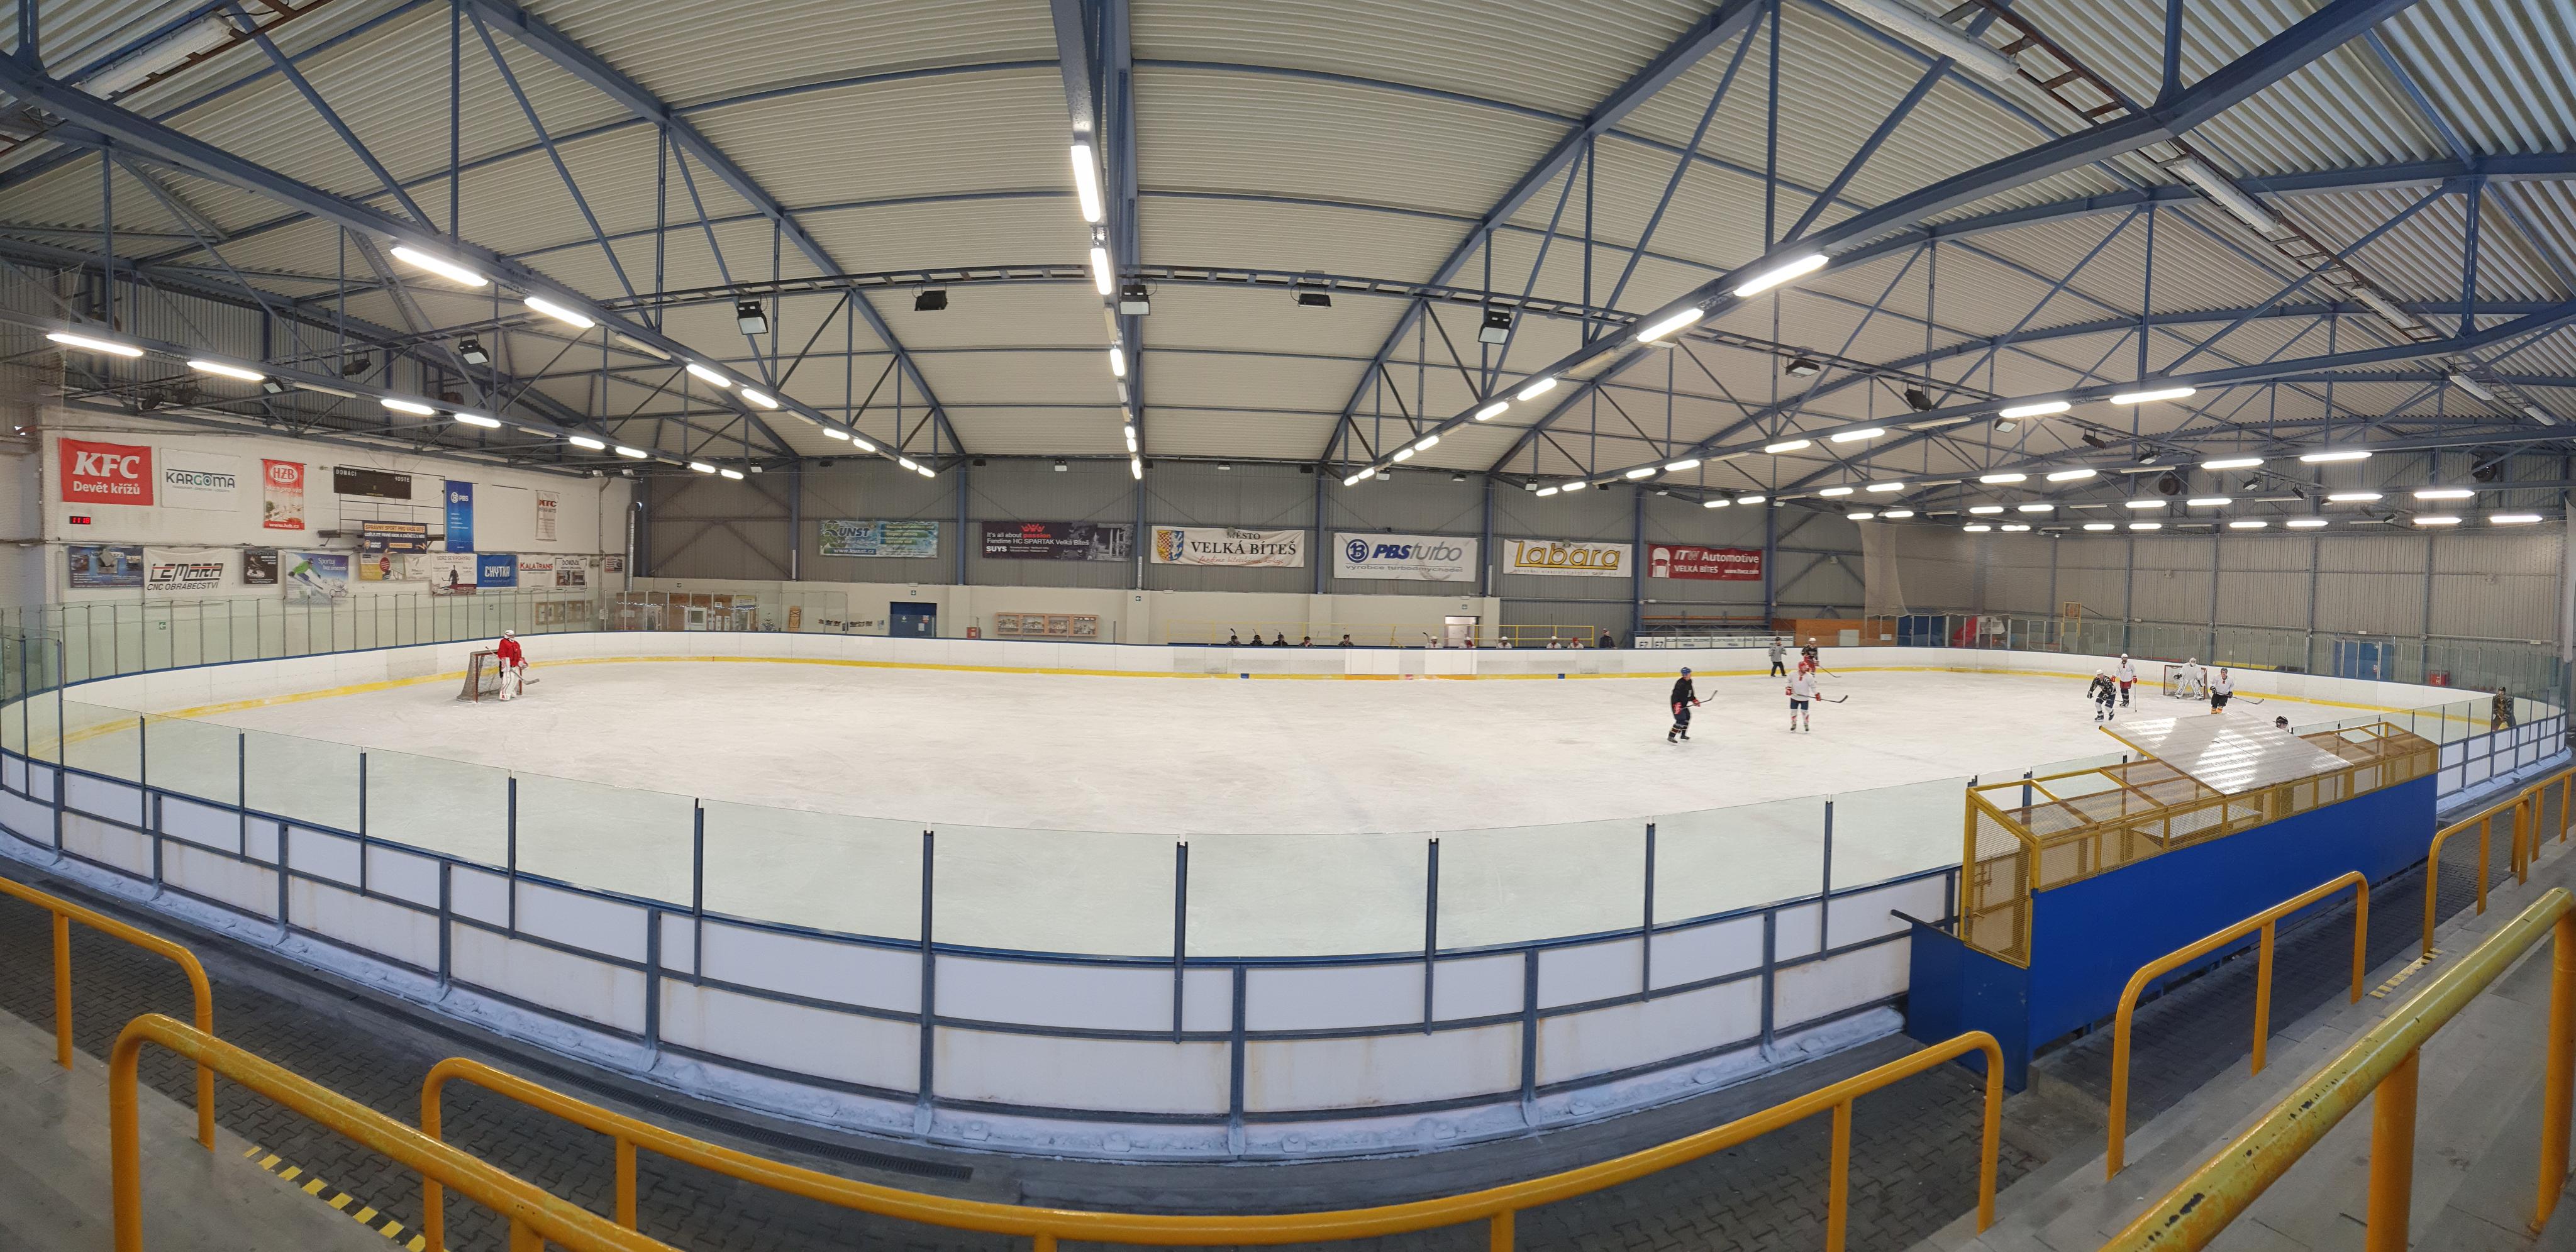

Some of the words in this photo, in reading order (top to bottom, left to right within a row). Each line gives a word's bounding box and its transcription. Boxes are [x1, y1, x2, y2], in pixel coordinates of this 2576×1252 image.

[72, 451, 140, 479] KFC
[166, 472, 235, 488] KARGOMA
[273, 467, 295, 480] HZB
[73, 480, 108, 494] Devět
[111, 482, 140, 495] křížů
[1191, 540, 1245, 555] VELKÁ
[1250, 541, 1296, 555] BÍTEŠ
[318, 557, 335, 566] Sportuj
[1514, 541, 1621, 570] Labara
[1701, 551, 1760, 563] Automotive
[150, 563, 224, 582] LEMARA
[484, 566, 510, 577] CHYTKA
[1674, 564, 1698, 572] VELKÁ
